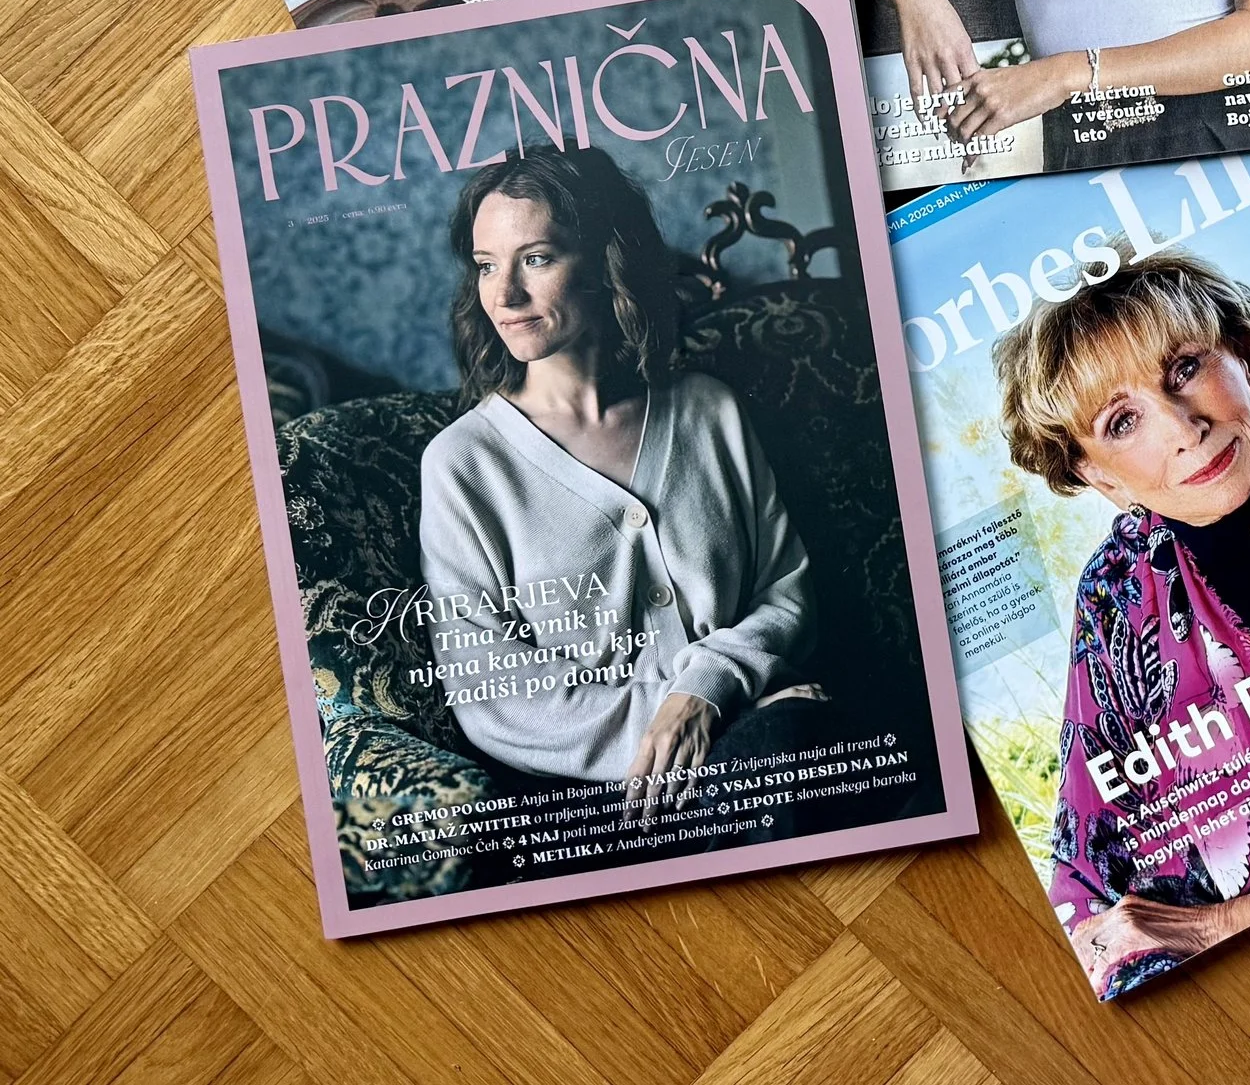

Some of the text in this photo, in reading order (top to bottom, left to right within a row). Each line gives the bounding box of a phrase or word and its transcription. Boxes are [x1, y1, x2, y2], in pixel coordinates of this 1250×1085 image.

[249, 18, 815, 201] PRAZNIČNA
[436, 606, 618, 652] Tina Zevnik in
[392, 808, 449, 827] GREMO
[451, 803, 473, 816] PO
[475, 797, 517, 814] GOBE
[520, 794, 549, 809] Anja
[552, 791, 563, 802] in
[567, 785, 602, 802] Bojan
[605, 780, 626, 793] Rot
[646, 762, 728, 787] VARČNOST
[799, 745, 827, 761] nuja
[830, 742, 844, 755] ali
[848, 736, 880, 753] trend
[1085, 708, 1233, 804] Edith
[1116, 813, 1137, 832] Az
[1123, 838, 1138, 852] is
[1140, 790, 1229, 844] mindennap
[1133, 833, 1194, 871] hogyan
[1193, 809, 1237, 839] lehet
